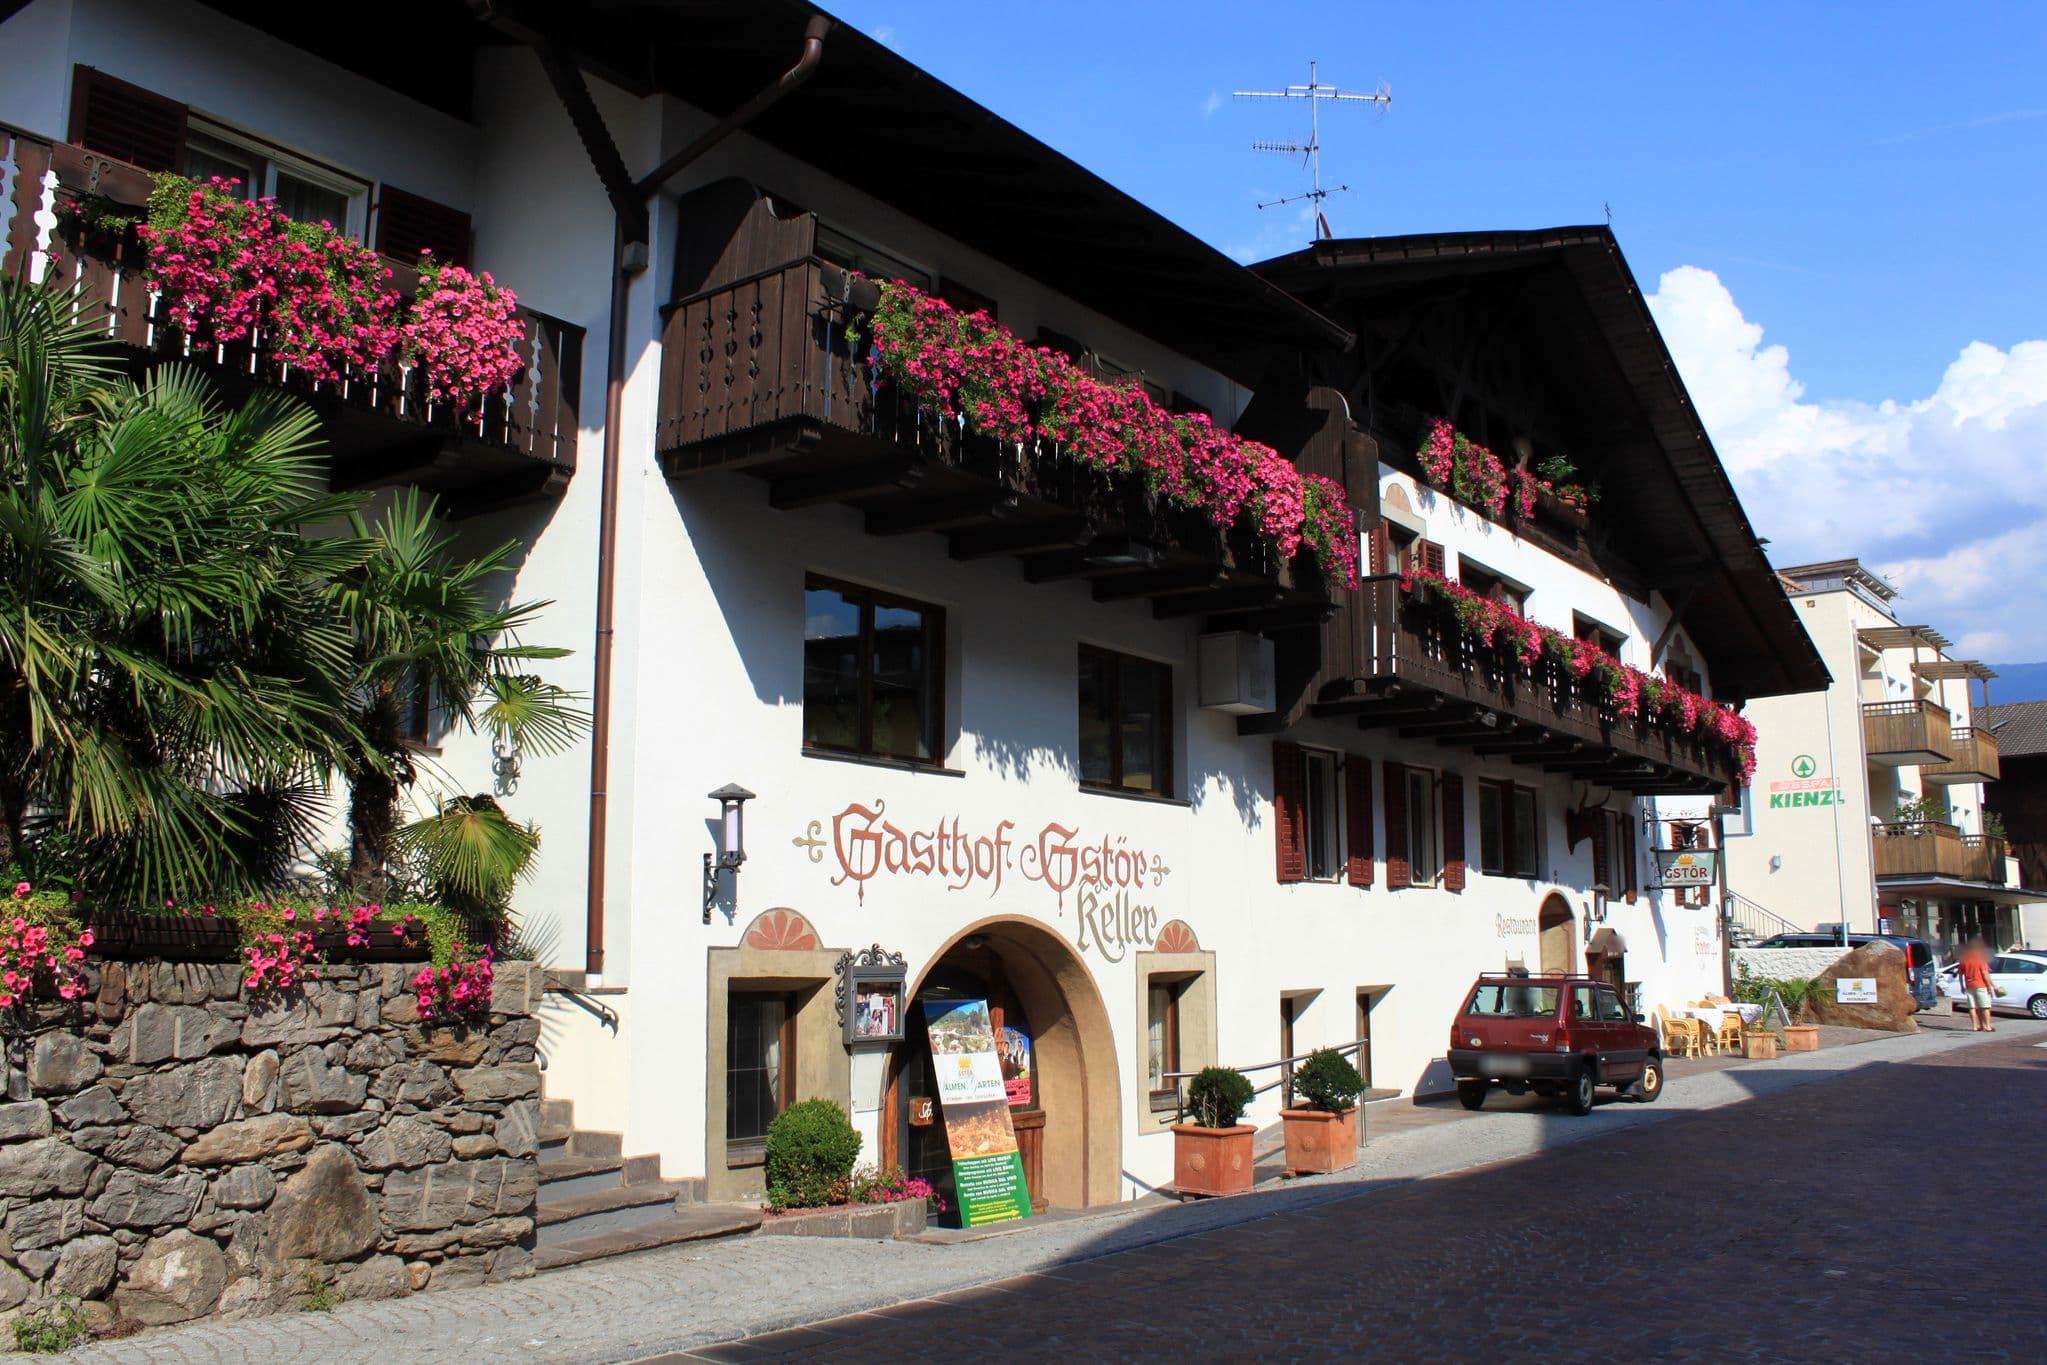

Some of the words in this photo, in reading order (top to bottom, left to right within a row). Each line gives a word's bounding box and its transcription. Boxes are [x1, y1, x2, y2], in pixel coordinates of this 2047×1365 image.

[831, 799, 1016, 907] Gasthof
[1020, 822, 1147, 917] Gstör
[1664, 865, 1707, 878] GSTÖR
[1076, 880, 1158, 964] Keller
